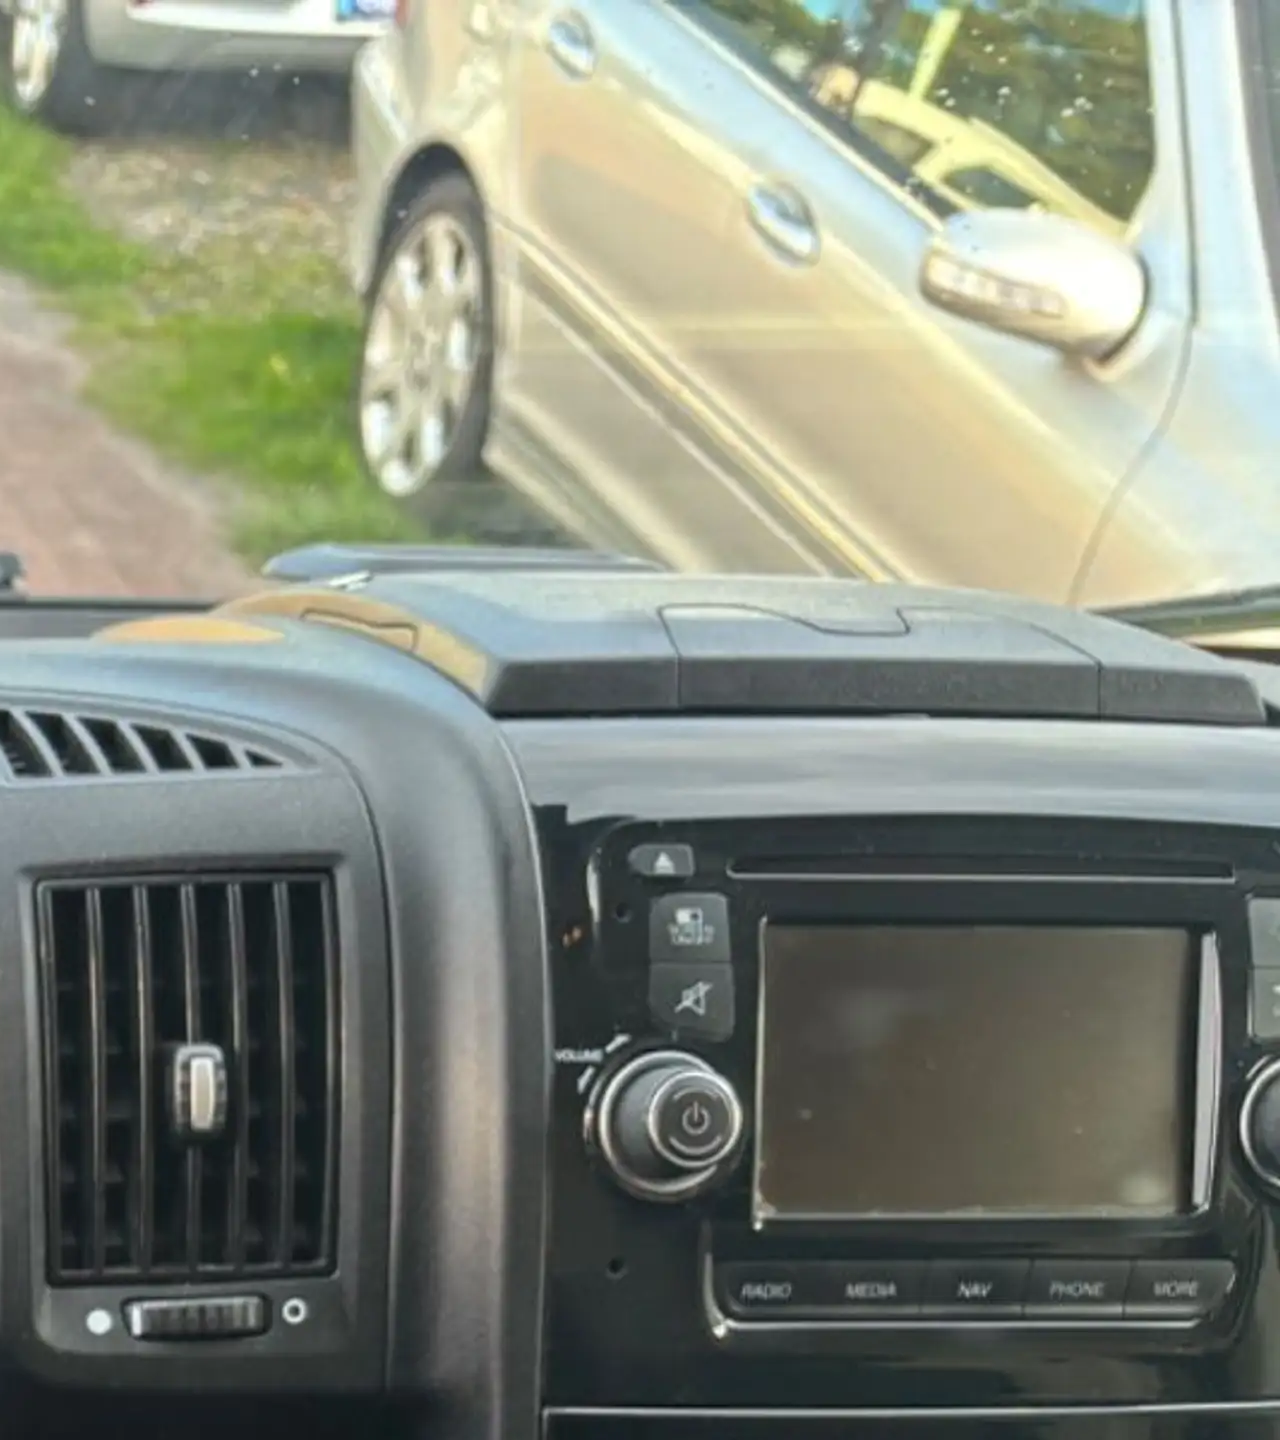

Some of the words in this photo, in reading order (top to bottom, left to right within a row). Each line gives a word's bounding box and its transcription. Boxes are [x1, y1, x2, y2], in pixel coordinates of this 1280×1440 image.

[742, 1282, 791, 1299] RADIO
[845, 1281, 897, 1299] MEDIA
[957, 1281, 993, 1299] NAV
[1049, 1280, 1104, 1298] PHONE
[1153, 1280, 1199, 1298] MORE
